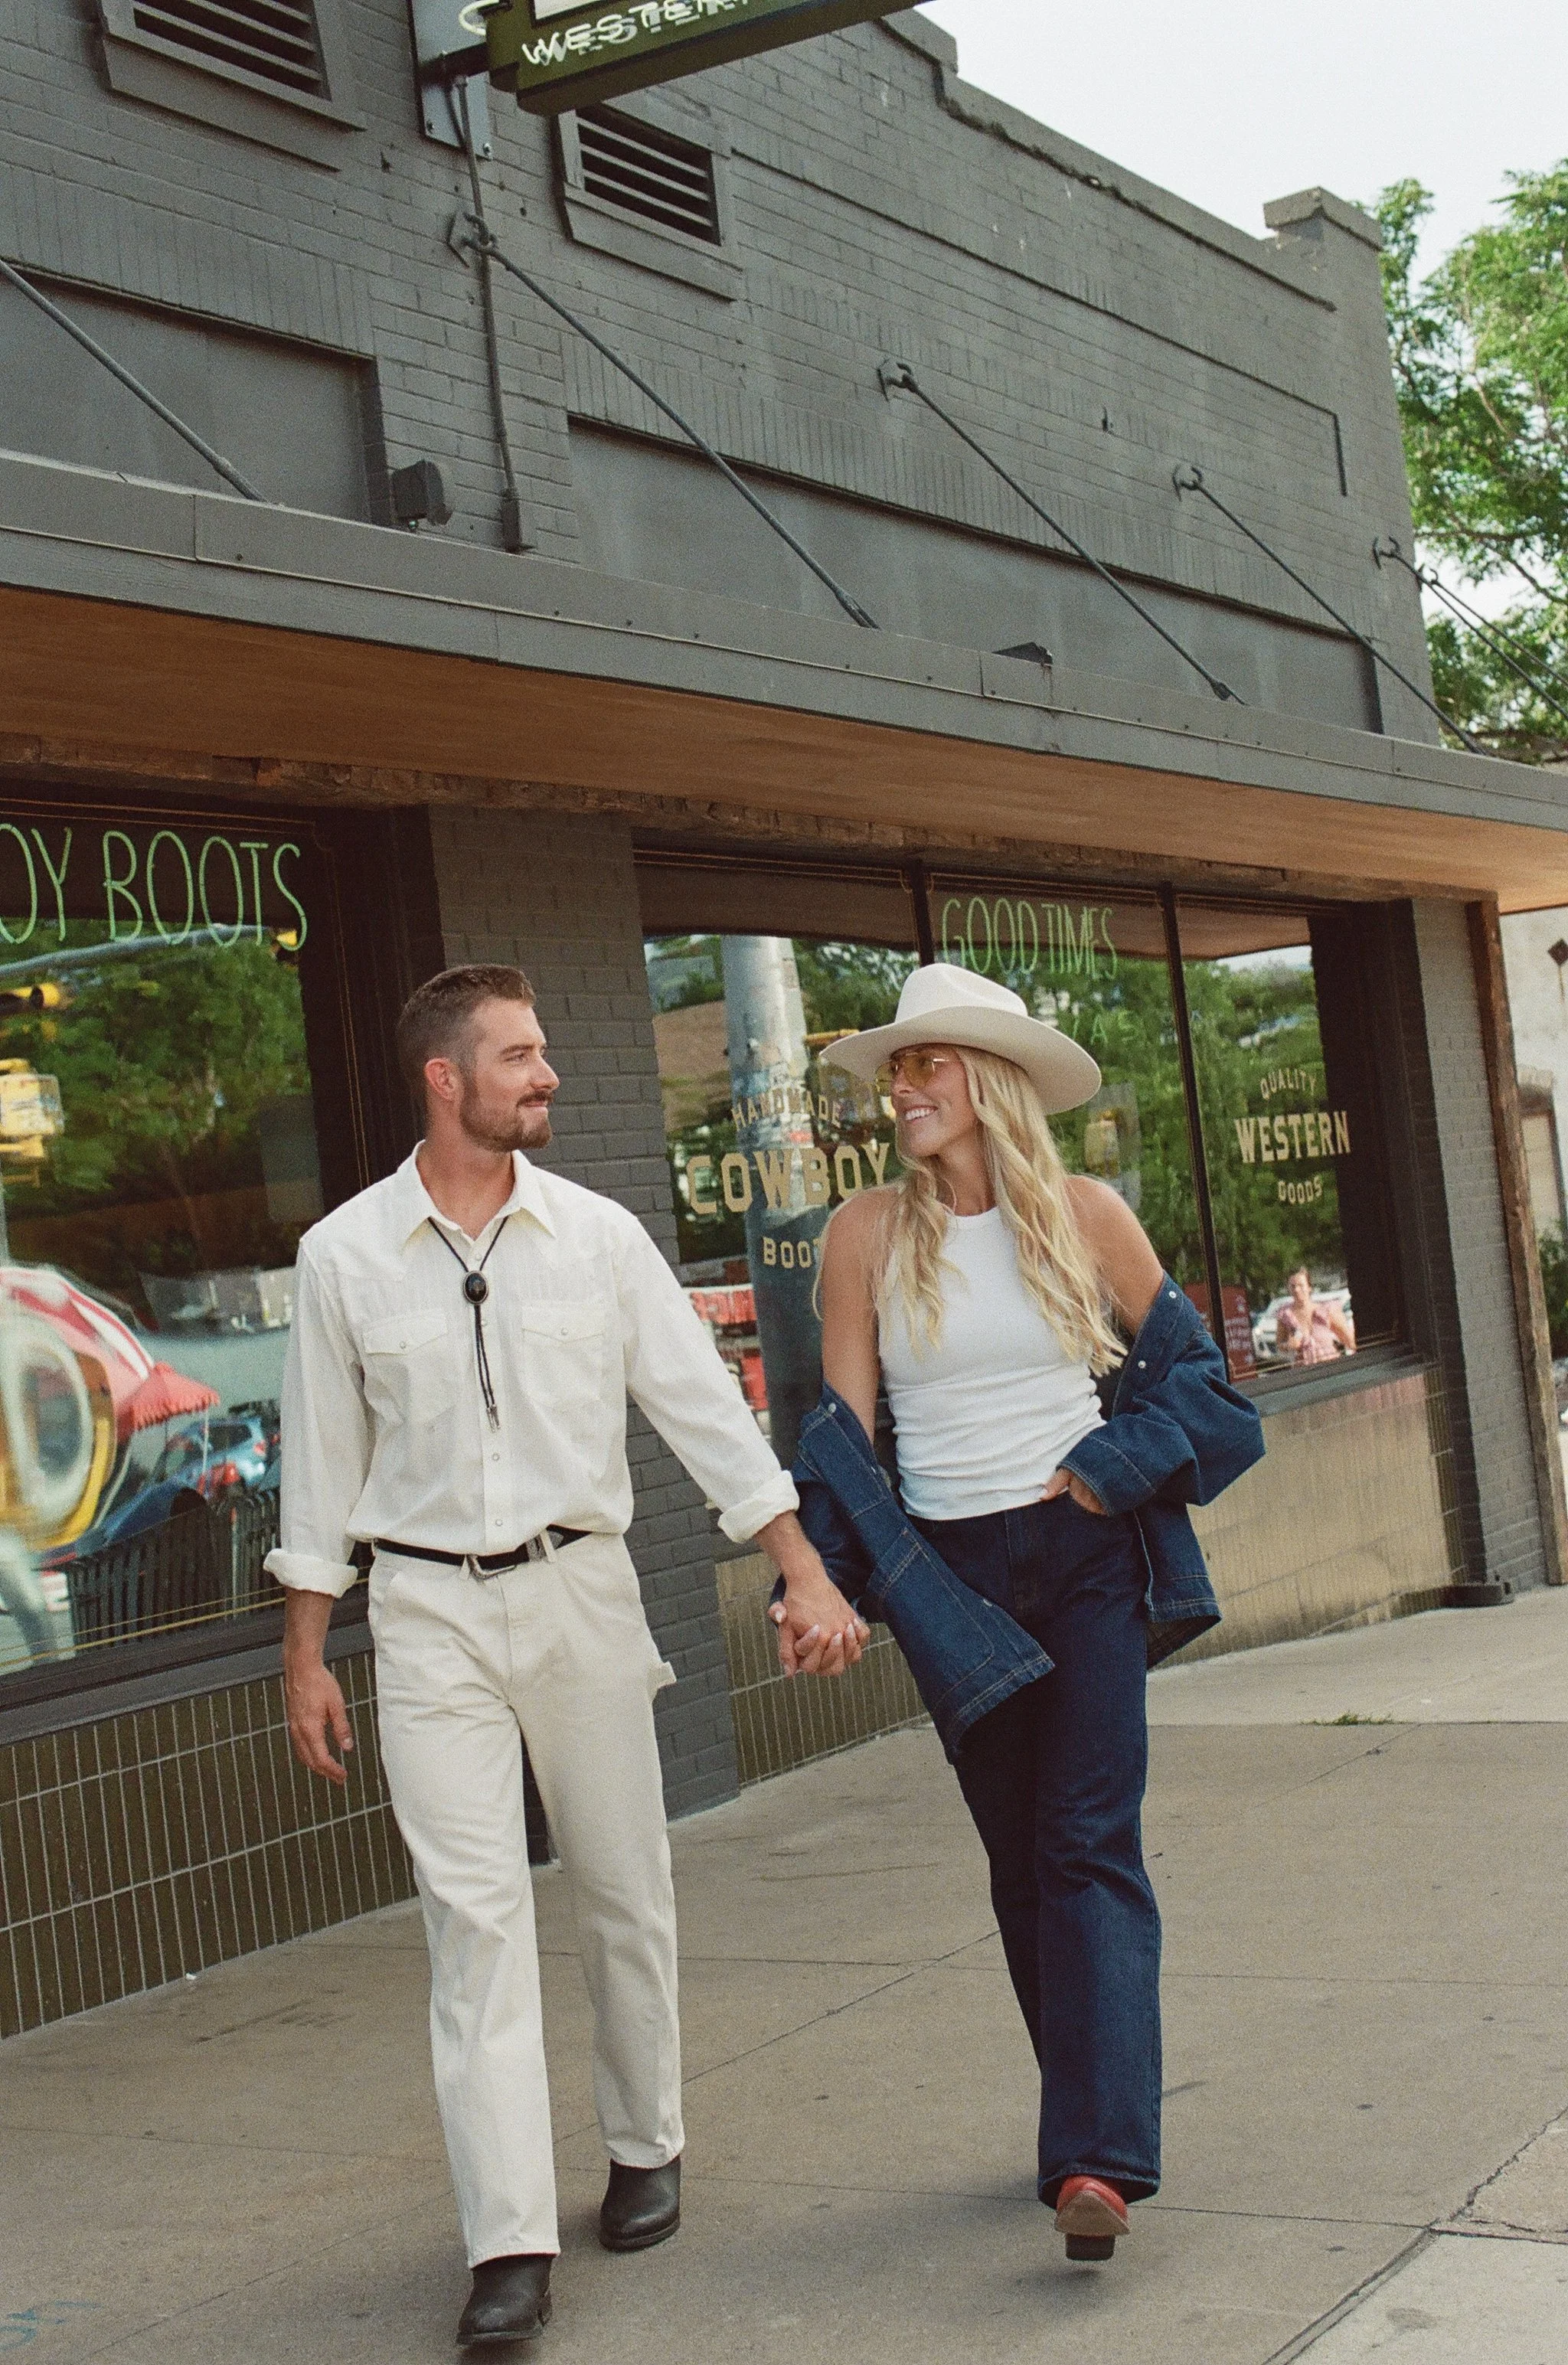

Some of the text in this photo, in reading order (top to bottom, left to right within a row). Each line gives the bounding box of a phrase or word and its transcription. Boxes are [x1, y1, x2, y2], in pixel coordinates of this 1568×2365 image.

[103, 830, 307, 952] BOOTS
[942, 897, 1118, 980] GOOD TIMES
[1260, 1067, 1317, 1100] QUALITY
[731, 1087, 841, 1132] HANDMADE
[1233, 1110, 1351, 1163] WESTERN
[686, 1142, 890, 1214] COWBOY
[1278, 1175, 1323, 1204] GOODS
[763, 1236, 819, 1269] BOO
